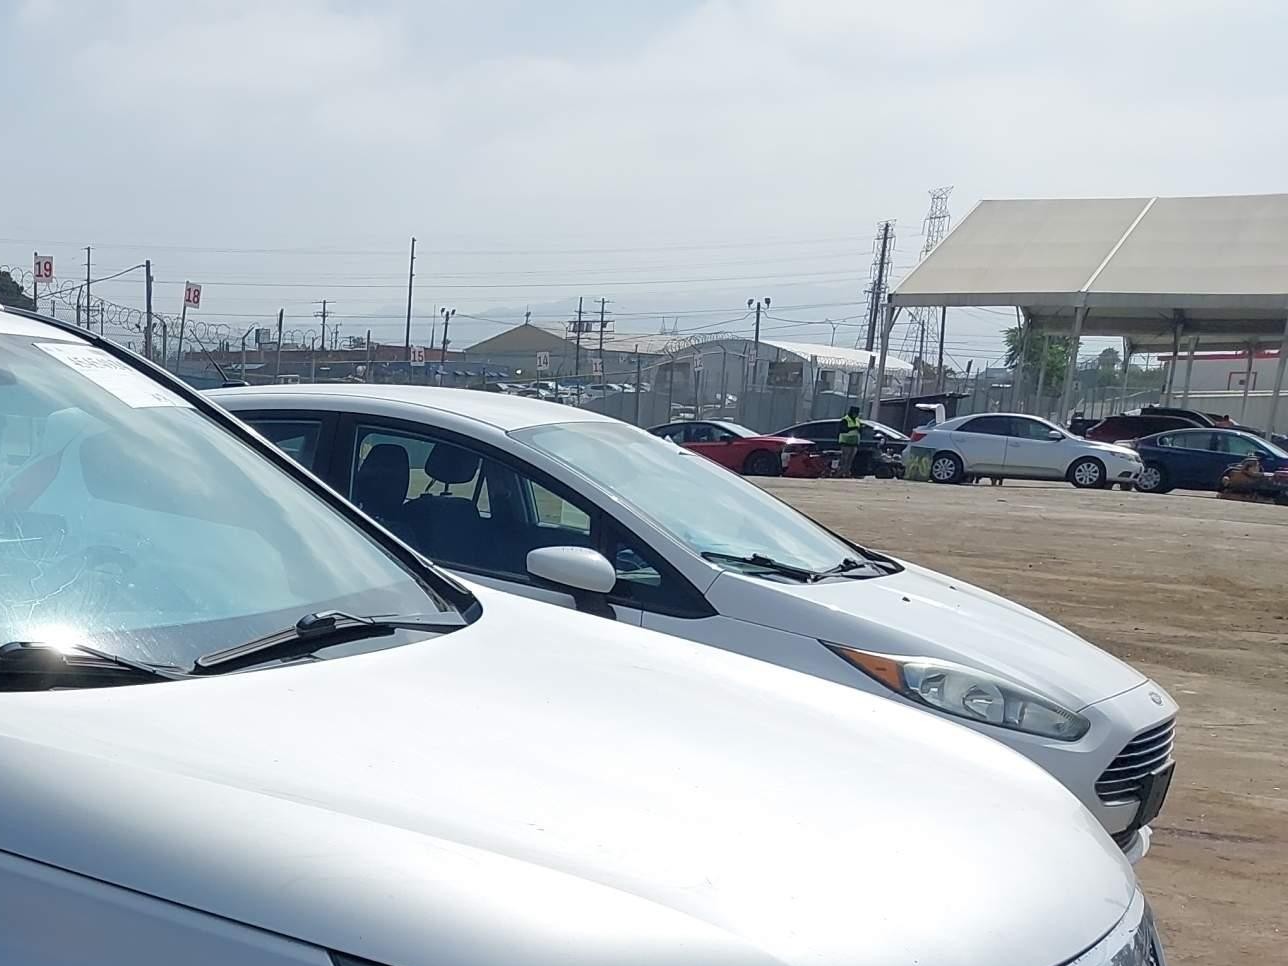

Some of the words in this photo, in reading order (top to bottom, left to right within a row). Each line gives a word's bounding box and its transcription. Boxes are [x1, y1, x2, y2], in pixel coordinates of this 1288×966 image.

[34, 260, 52, 278] 19
[185, 287, 200, 304] 18
[411, 350, 424, 363] 15
[537, 354, 548, 367] 14
